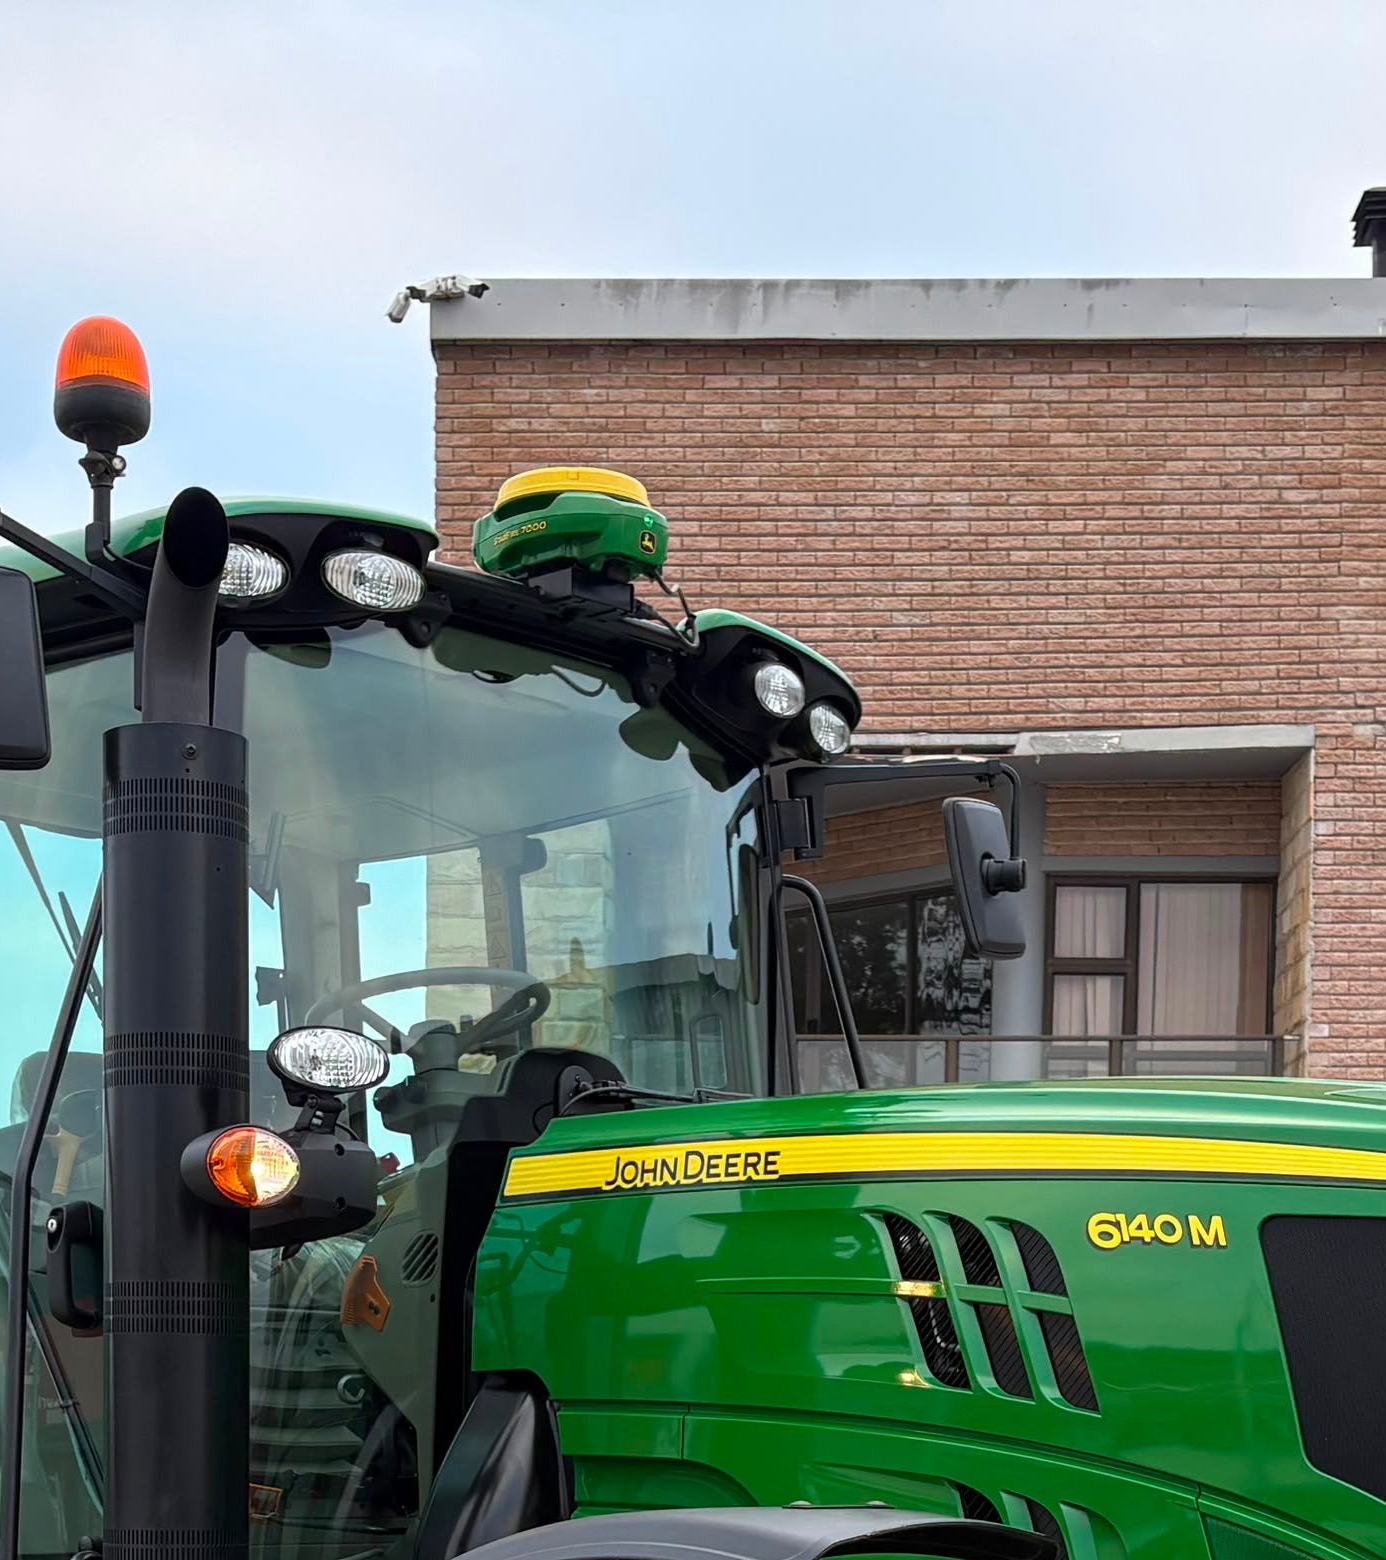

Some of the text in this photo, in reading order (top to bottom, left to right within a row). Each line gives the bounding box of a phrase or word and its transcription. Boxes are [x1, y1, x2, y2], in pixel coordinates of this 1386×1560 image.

[604, 1150, 782, 1187] JOHN DEERE
[1087, 1212, 1228, 1250] 6140 M
